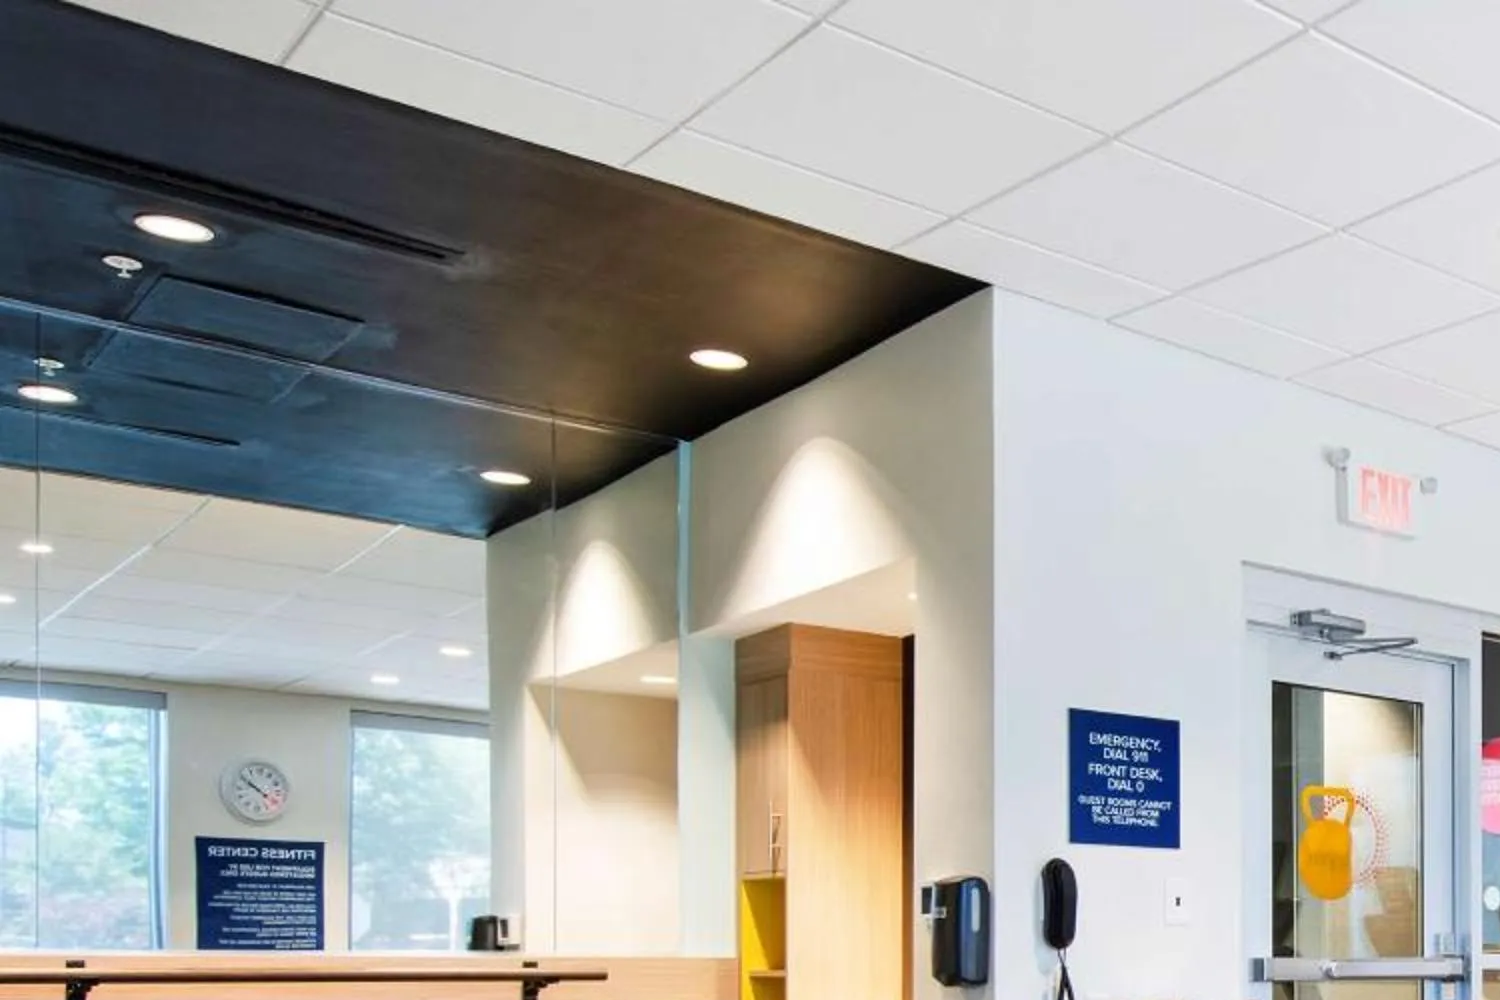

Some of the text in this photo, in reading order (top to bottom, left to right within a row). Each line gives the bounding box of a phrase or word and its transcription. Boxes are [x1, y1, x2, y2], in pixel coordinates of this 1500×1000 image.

[1360, 466, 1412, 526] EXIT
[1088, 732, 1162, 752] EMERGENCY,
[1103, 748, 1149, 763] DIAL 911
[1087, 763, 1163, 783] FRONT DESK,
[1107, 778, 1133, 791] DIAL
[1078, 794, 1172, 811] GUEST ROOMS CANNOT
[1091, 805, 1160, 818] BE CALLED FROM
[1093, 814, 1111, 824] THIS
